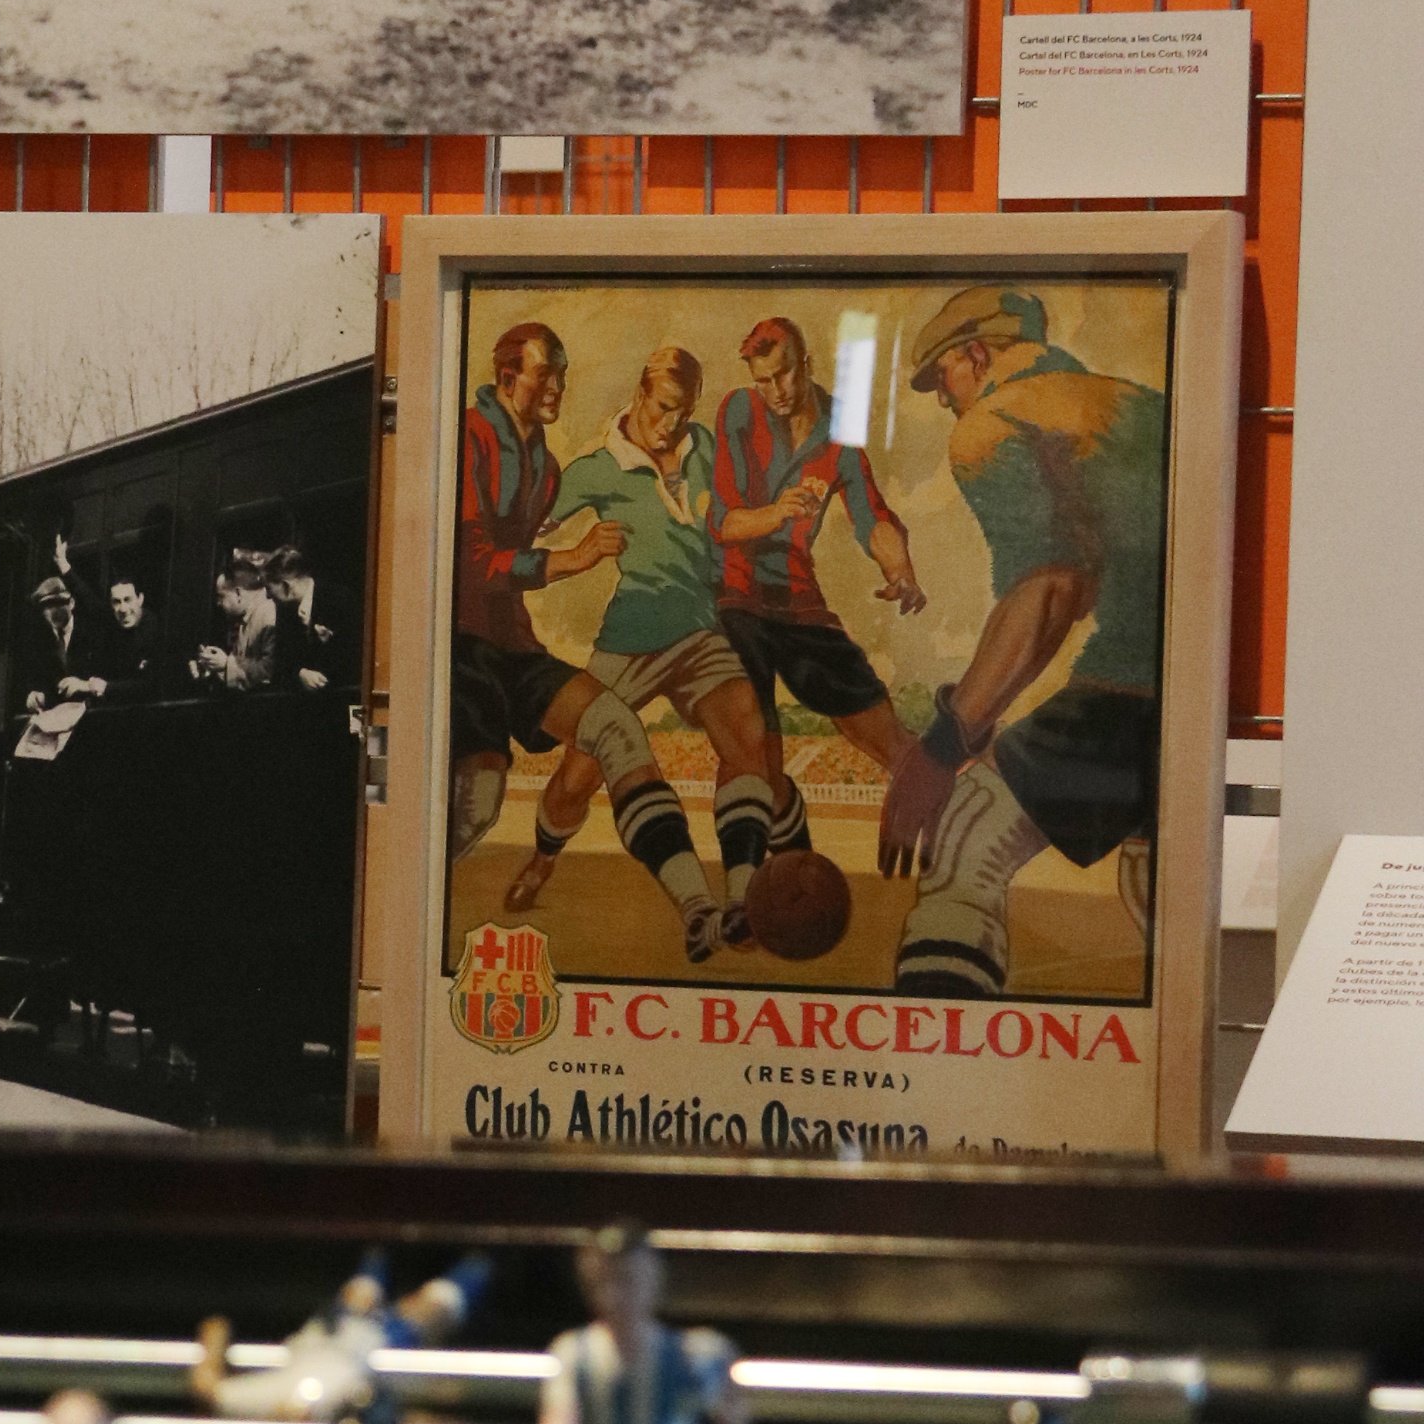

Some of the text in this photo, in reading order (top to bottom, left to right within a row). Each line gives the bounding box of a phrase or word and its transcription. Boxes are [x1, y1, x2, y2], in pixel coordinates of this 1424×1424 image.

[1019, 36, 1050, 44] Cartell
[1051, 35, 1065, 44] del
[1067, 35, 1080, 44] FC
[1137, 34, 1150, 42] les
[1181, 33, 1202, 42] 1924
[1019, 51, 1046, 60] Cartel
[1048, 51, 1062, 60] del
[1064, 51, 1077, 59] FC
[1140, 50, 1156, 58] Les
[1187, 49, 1208, 57] 1924
[1018, 67, 1047, 76] Poster
[1048, 67, 1061, 75] for
[1063, 66, 1076, 75] FC
[1177, 65, 1200, 74] 1924
[1017, 100, 1038, 109] MDC
[1382, 862, 1424, 872] De ju
[1362, 910, 1373, 918] la
[1364, 930, 1404, 938] pagar
[1396, 959, 1414, 967] de
[1339, 968, 1384, 976] clubes
[1350, 977, 1417, 986] distinción
[699, 998, 1141, 1064] BARCELONA
[548, 1061, 625, 1076] CONTRA
[744, 1065, 912, 1093] (RESERVA)
[465, 1084, 551, 1142] Club
[565, 1089, 747, 1148] Athlético
[761, 1099, 929, 1156] Osasuna
